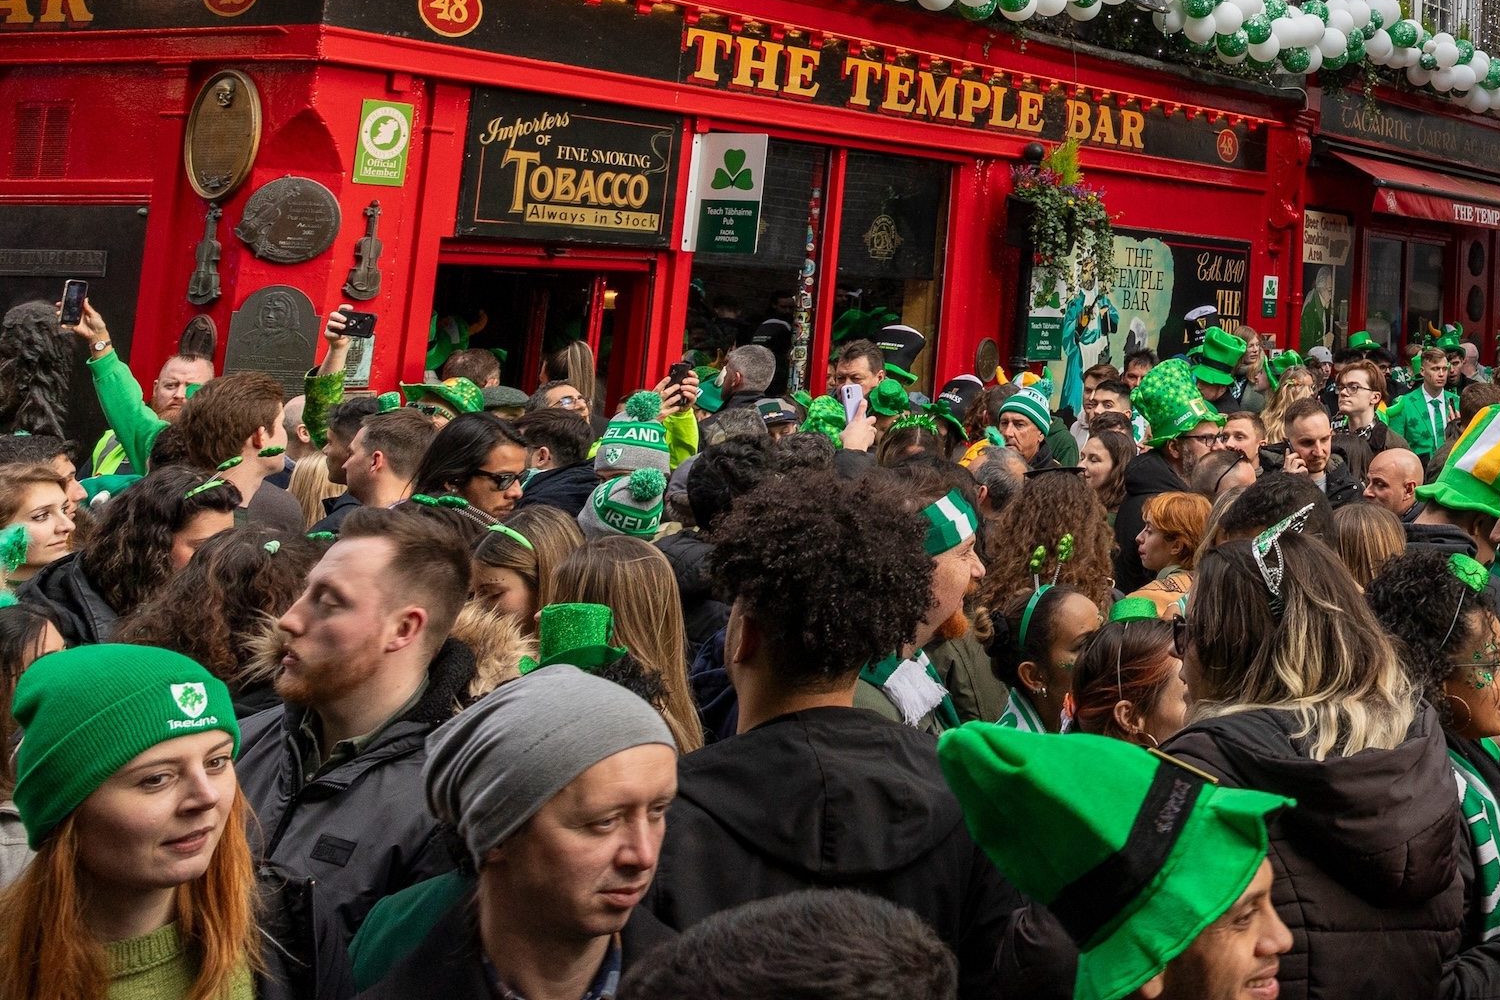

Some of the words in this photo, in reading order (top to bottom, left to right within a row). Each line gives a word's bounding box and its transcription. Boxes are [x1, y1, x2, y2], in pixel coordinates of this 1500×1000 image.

[686, 27, 820, 98] THE
[845, 57, 1045, 133] TEMPLE
[1065, 99, 1145, 150] BAR
[479, 111, 570, 149] Importers
[535, 134, 551, 146] OF
[1220, 137, 1234, 156] 48
[367, 158, 397, 169] Official
[557, 145, 589, 163] FINE
[591, 149, 651, 169] SMOKING
[363, 167, 398, 177] Member
[528, 205, 586, 223] Always
[594, 211, 608, 225] in
[613, 211, 657, 229] Stock
[707, 207, 724, 216] Teach
[1453, 204, 1474, 222] THE
[722, 217, 735, 226] Pub
[1304, 231, 1330, 249] Smoking
[1125, 247, 1153, 269] THE
[1308, 247, 1323, 261] Area
[1223, 259, 1246, 284] 1840
[1122, 290, 1150, 313] BAR
[1216, 289, 1241, 316] THE
